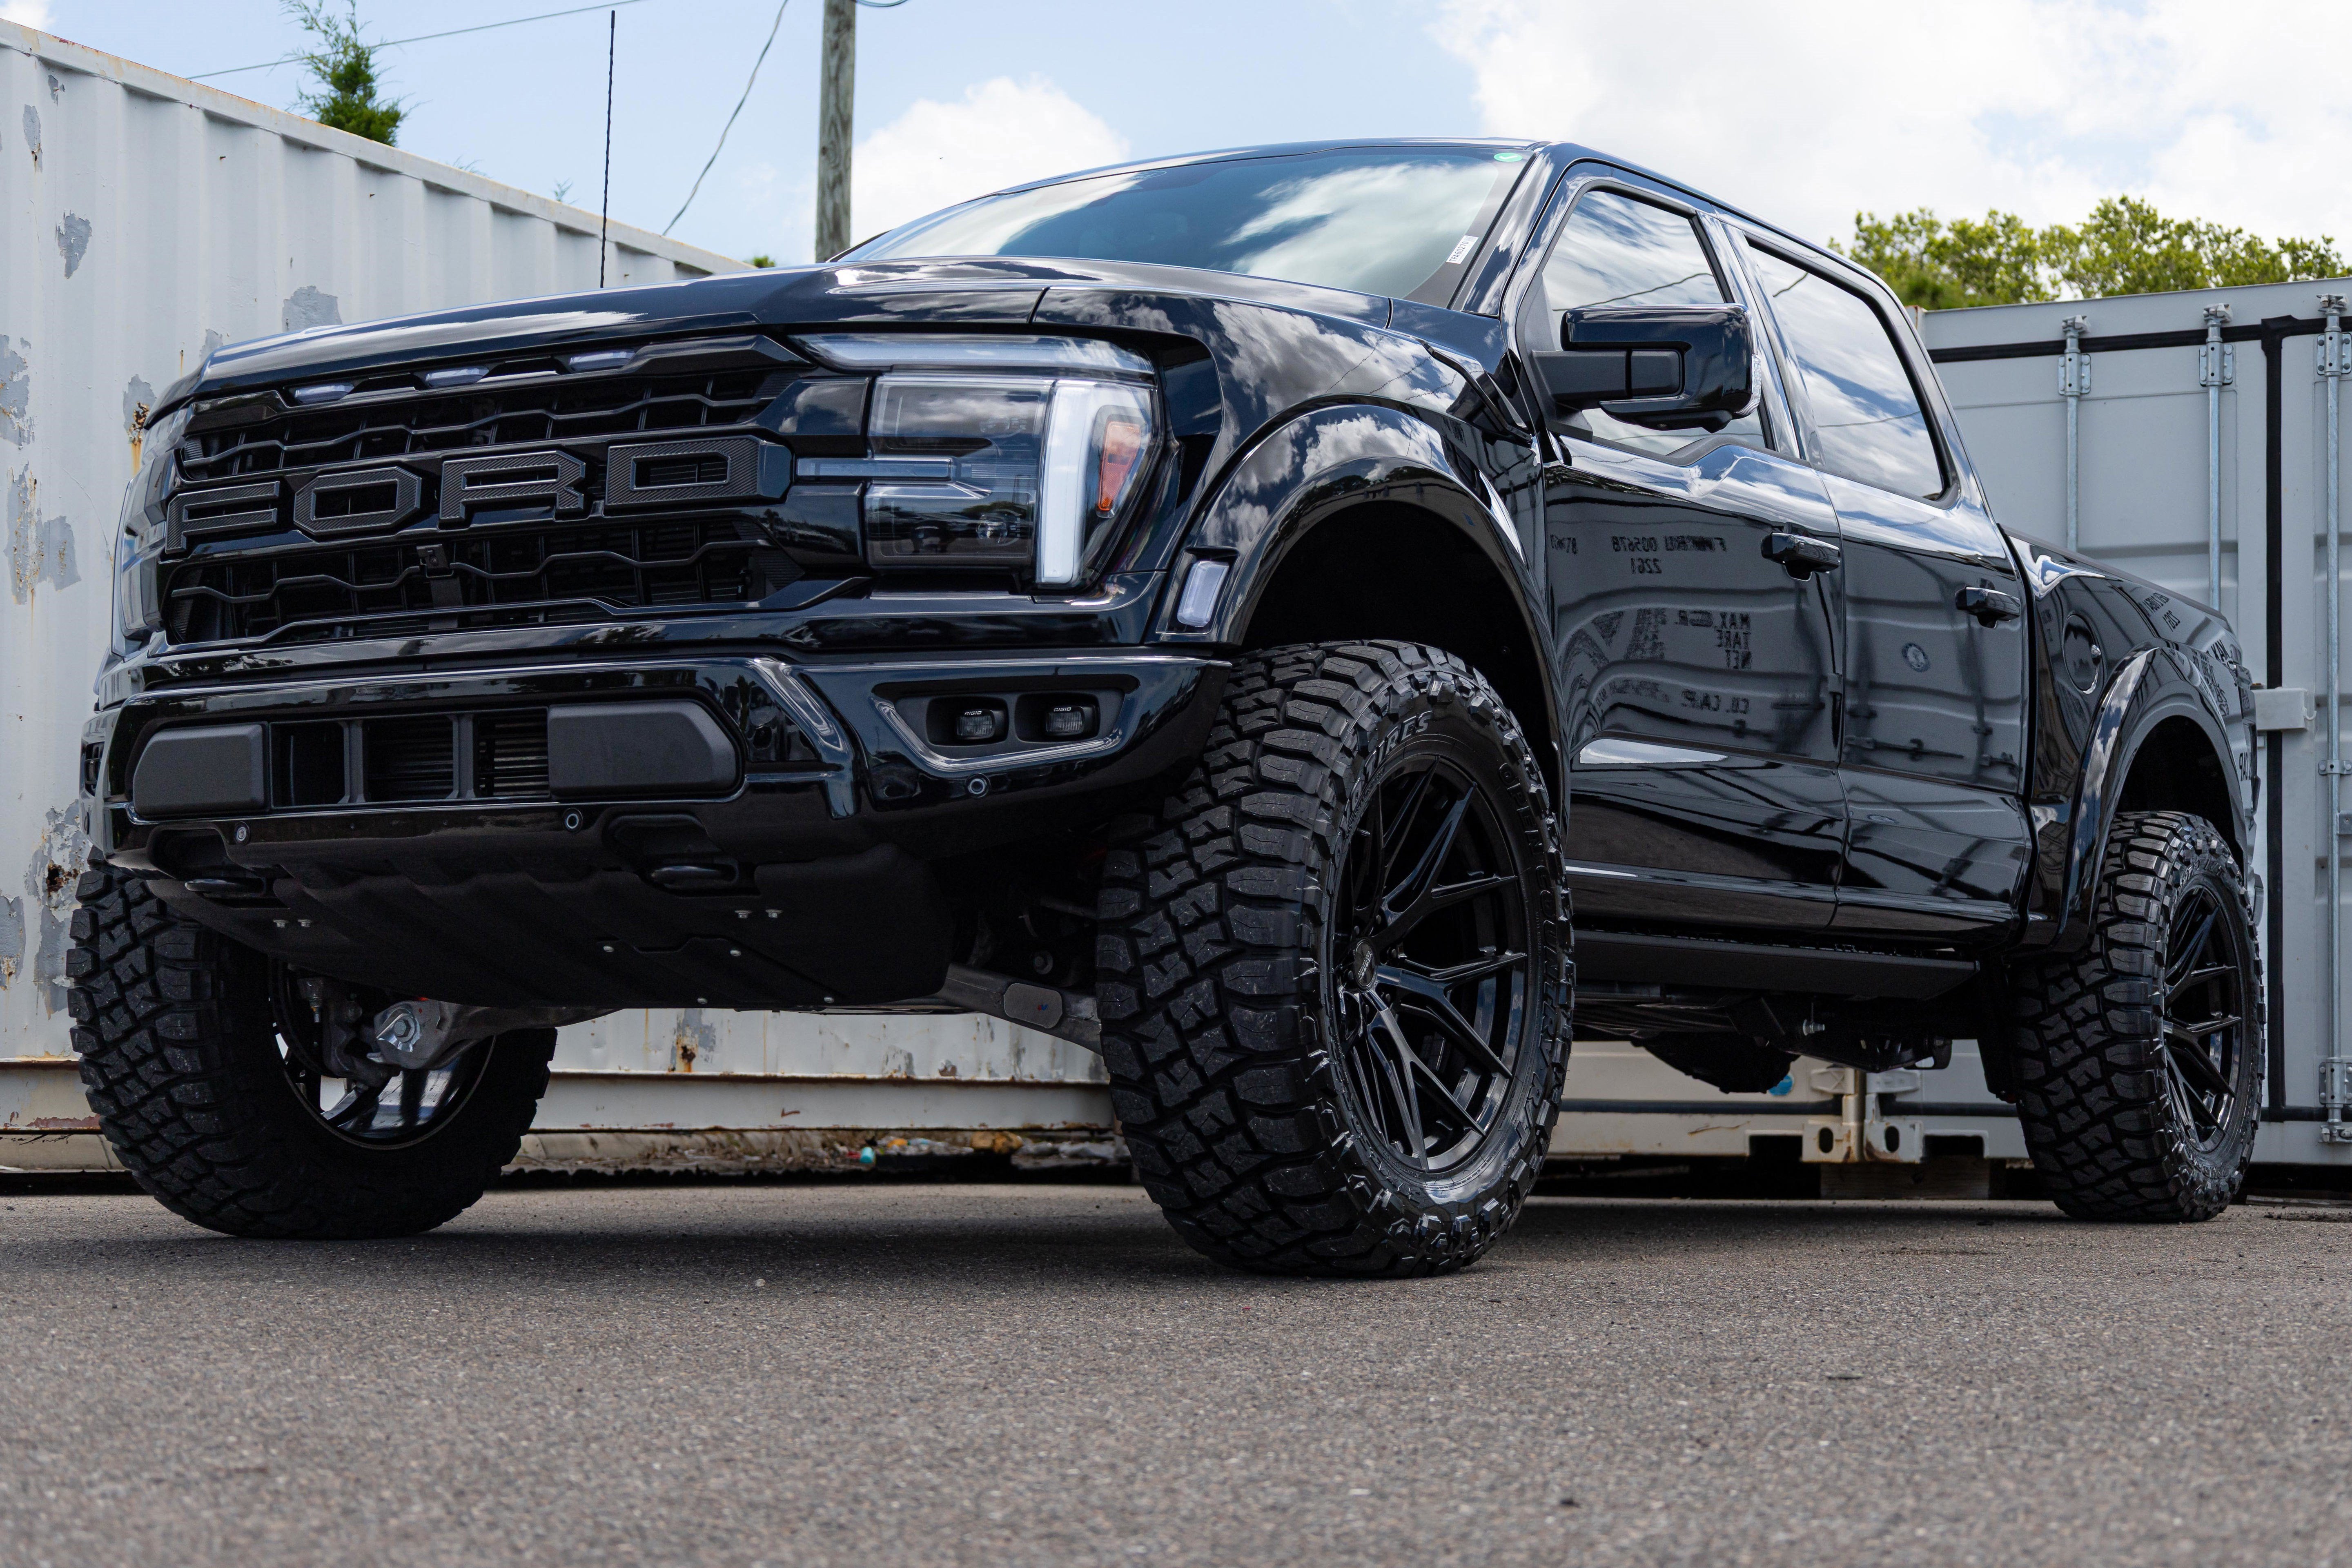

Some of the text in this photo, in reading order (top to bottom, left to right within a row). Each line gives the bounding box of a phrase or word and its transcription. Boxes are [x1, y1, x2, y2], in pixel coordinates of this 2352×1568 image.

[1449, 241, 1469, 262] TFA60270
[165, 435, 793, 555] FORD
[1363, 710, 1433, 782] TIRES
[1498, 761, 1545, 858] OPEN
[1535, 864, 1559, 1068] COUNTRY
[1514, 1073, 1545, 1151] R/T
